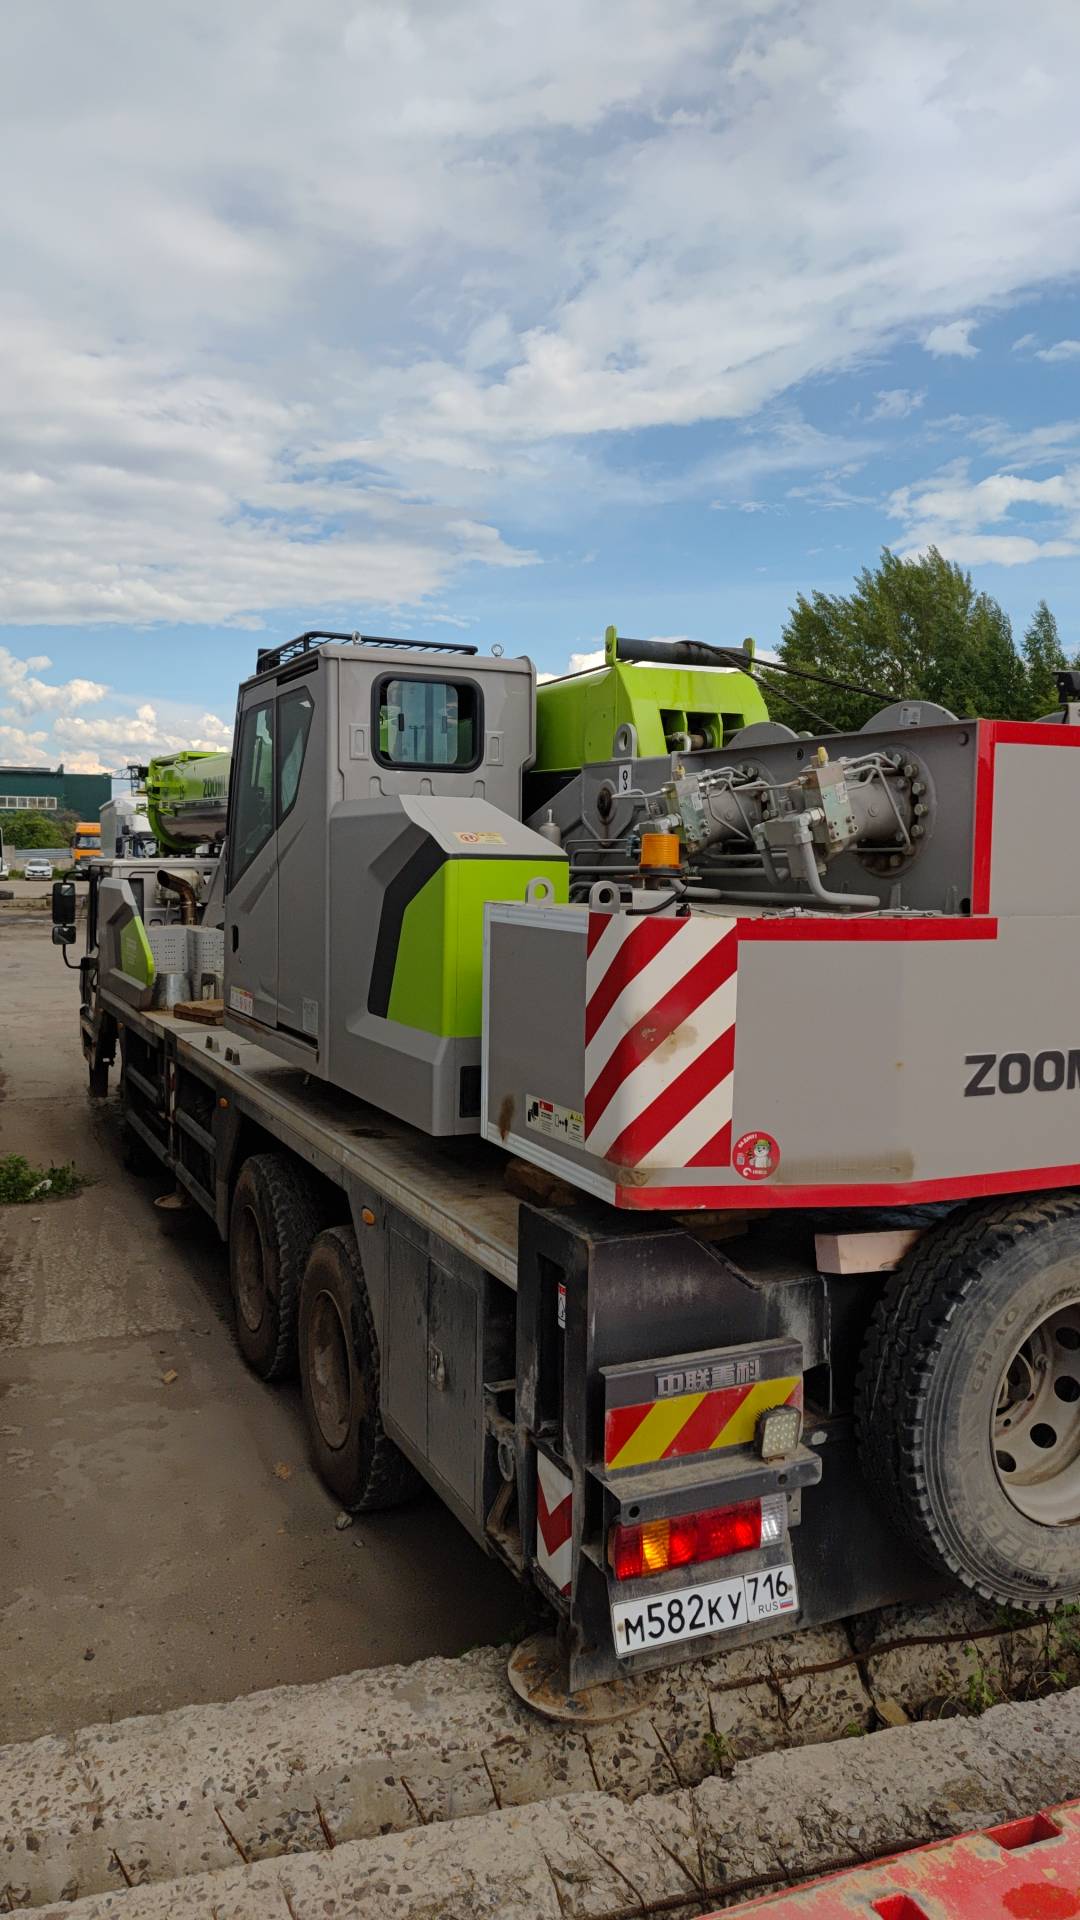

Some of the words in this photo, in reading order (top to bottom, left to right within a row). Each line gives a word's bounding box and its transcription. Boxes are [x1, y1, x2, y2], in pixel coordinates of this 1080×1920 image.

[656, 1358, 760, 1397] 中联重科
[624, 1592, 742, 1646] М582КУ
[747, 1571, 788, 1605] 716
[758, 1600, 779, 1614] RUS
